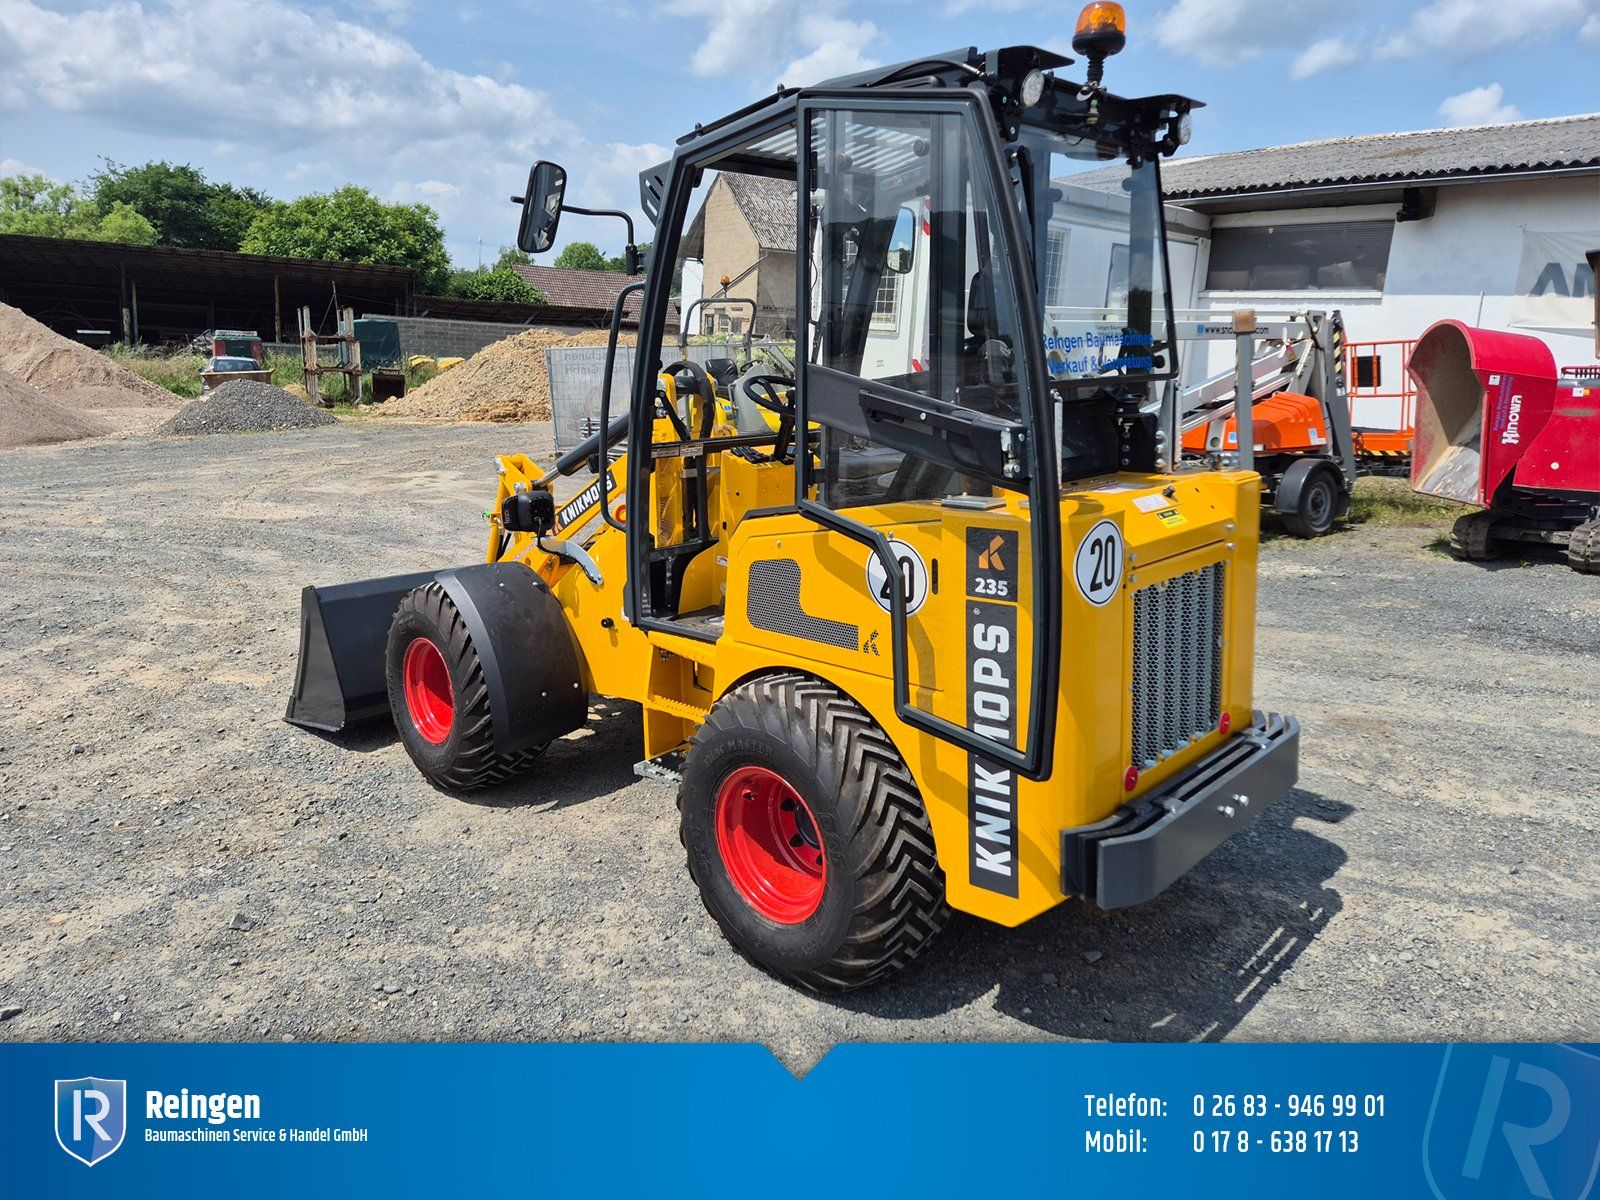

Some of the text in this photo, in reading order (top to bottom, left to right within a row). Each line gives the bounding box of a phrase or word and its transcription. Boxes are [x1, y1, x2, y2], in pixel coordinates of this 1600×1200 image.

[1042, 331, 1153, 353] Reingen Baumaschinen
[1047, 356, 1088, 374] Verkauf
[1501, 394, 1522, 445] Hinowa
[560, 474, 613, 525] KNIKMOS
[1090, 534, 1116, 592] 20
[974, 577, 1009, 597] 235
